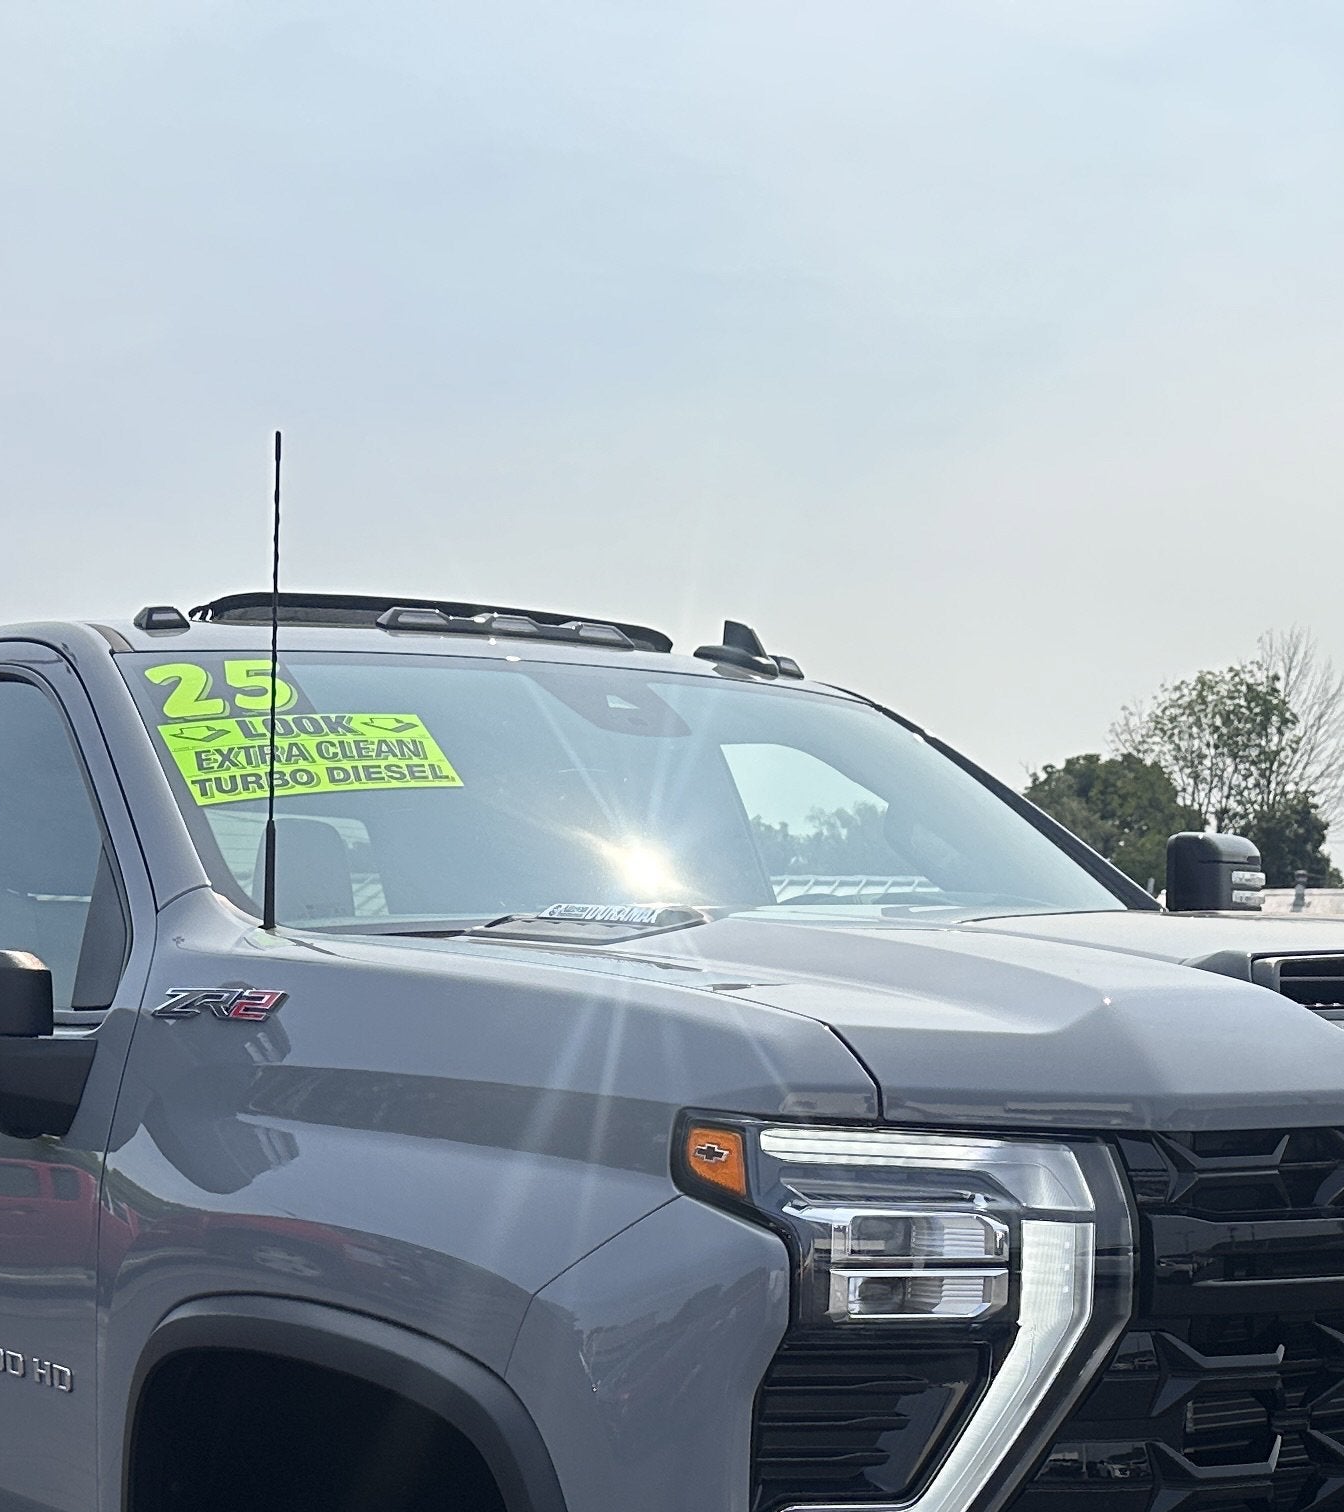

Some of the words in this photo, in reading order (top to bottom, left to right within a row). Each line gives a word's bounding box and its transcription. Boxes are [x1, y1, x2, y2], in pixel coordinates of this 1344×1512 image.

[144, 659, 298, 721] 25
[235, 714, 364, 741] LOOK
[194, 744, 316, 772] EXTRA
[316, 739, 429, 762] CLEAN
[190, 768, 321, 799] TURBO
[326, 763, 456, 785] DIESEL
[151, 987, 289, 1022] ZR2
[32, 1357, 73, 1392] HD
